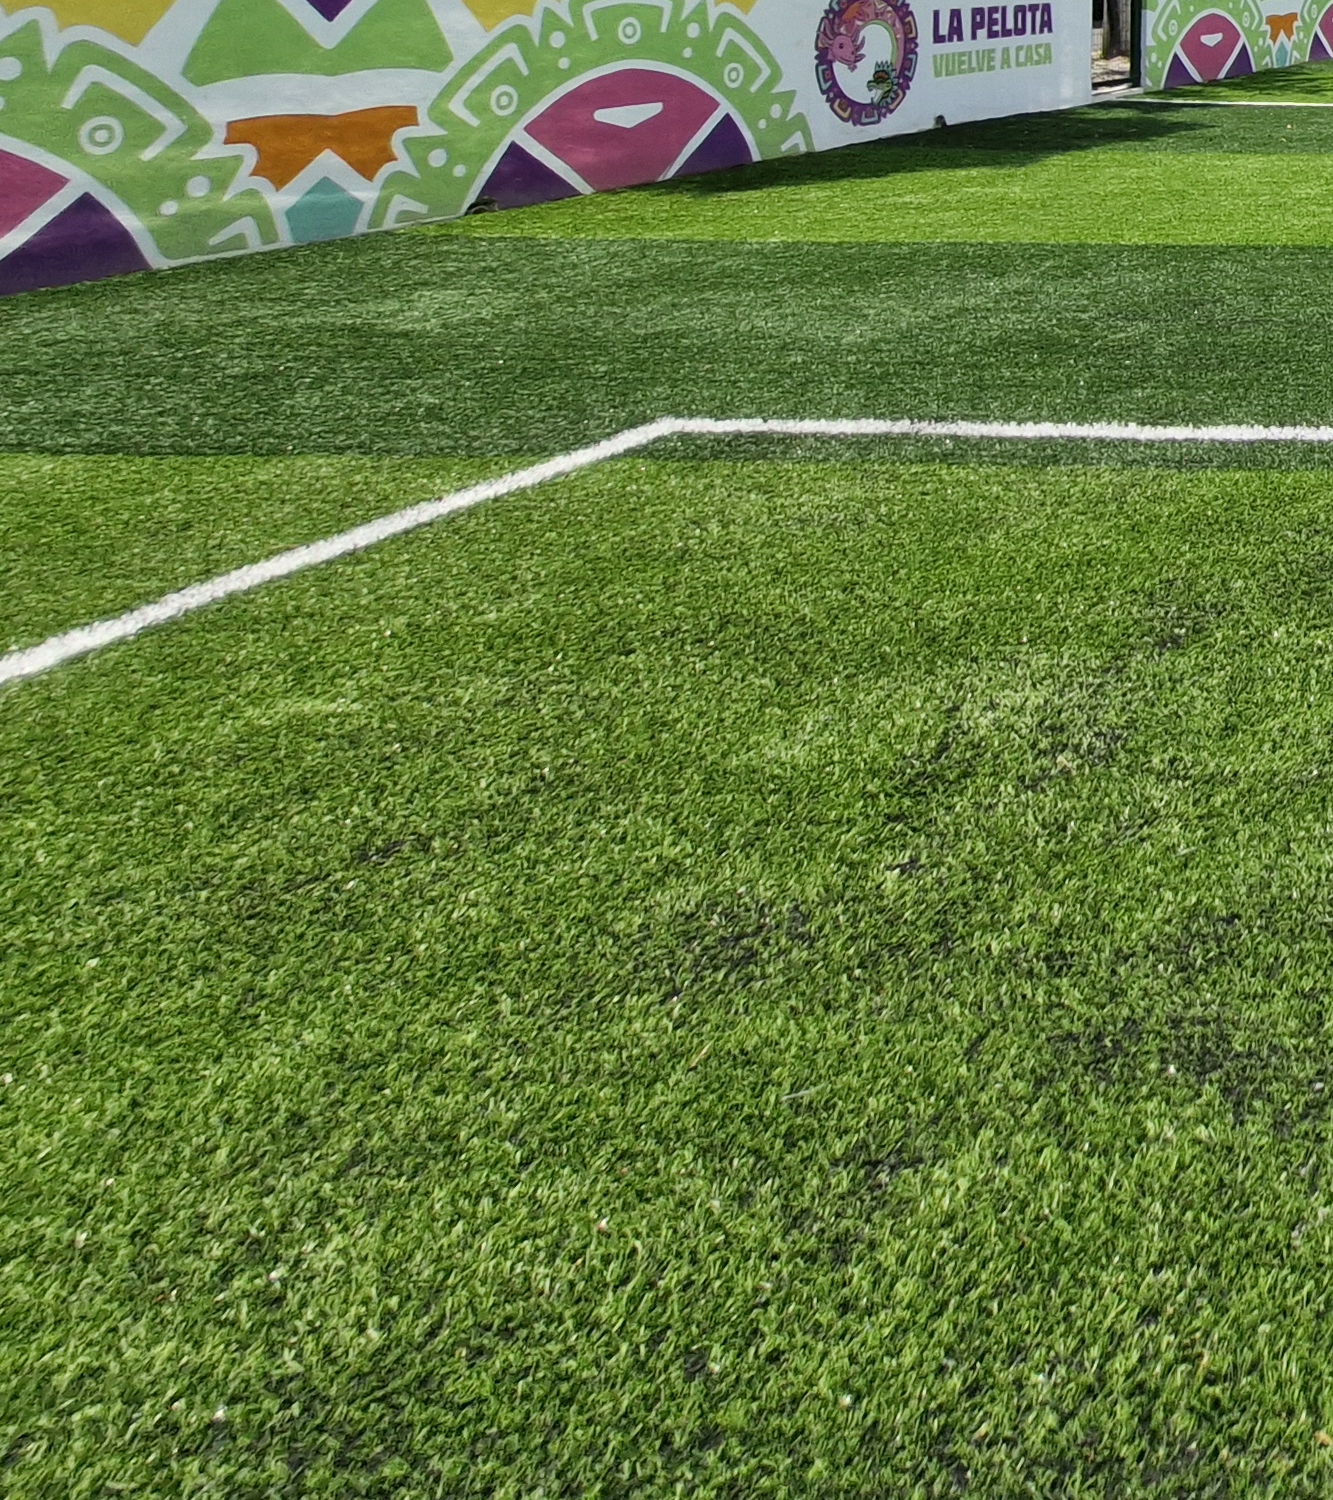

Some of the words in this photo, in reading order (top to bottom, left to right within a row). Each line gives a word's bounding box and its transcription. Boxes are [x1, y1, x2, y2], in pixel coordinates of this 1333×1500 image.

[932, 8, 964, 44] LA
[970, 2, 1053, 40] PELOTA
[932, 48, 996, 78] VUELVE
[1001, 46, 1012, 69] A
[1015, 42, 1053, 68] CASA
